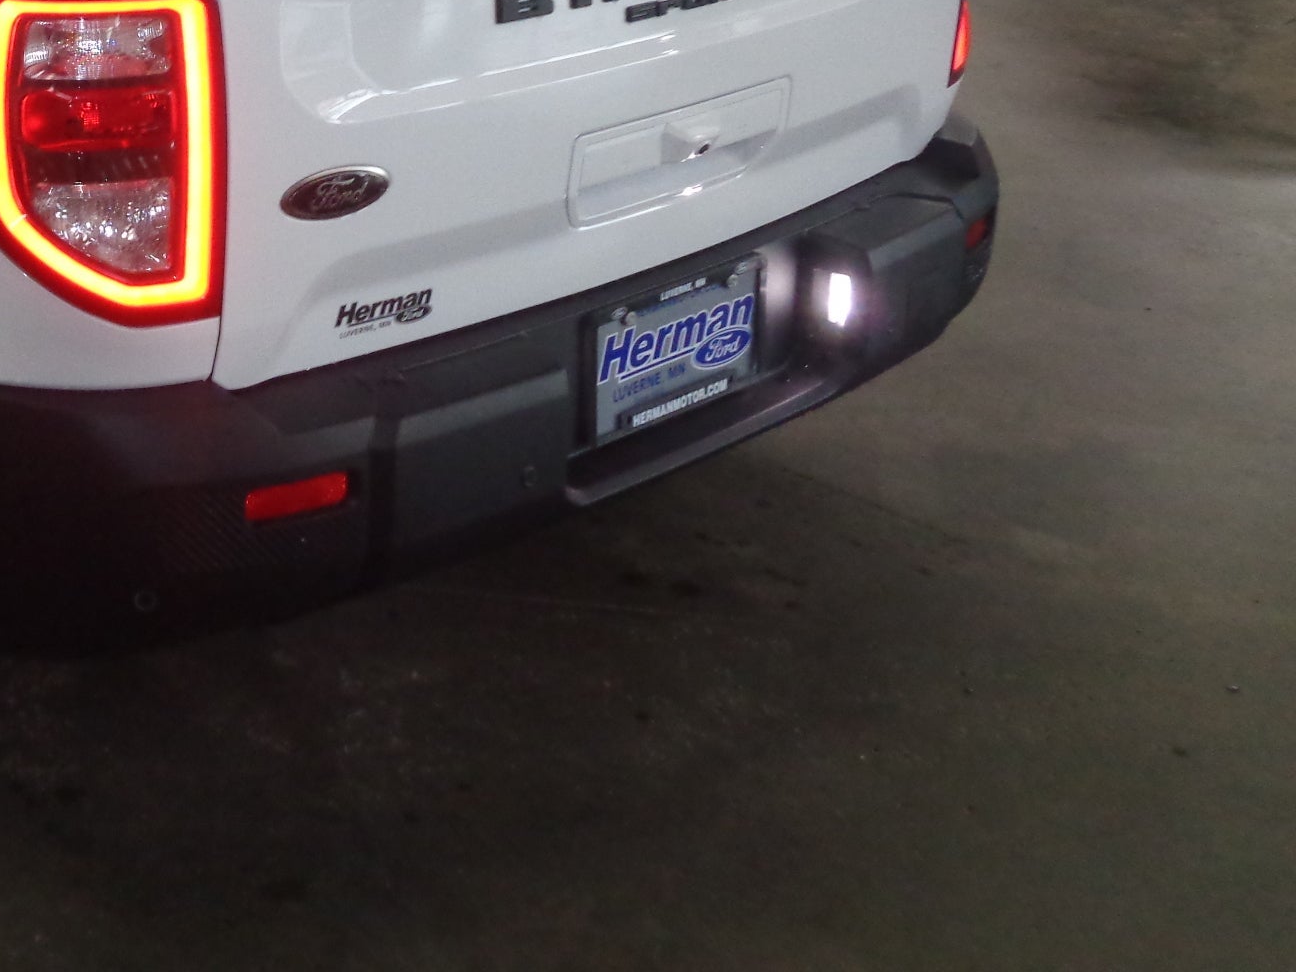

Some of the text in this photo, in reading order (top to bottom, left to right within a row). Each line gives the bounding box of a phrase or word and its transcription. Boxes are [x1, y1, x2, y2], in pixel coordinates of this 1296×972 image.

[335, 288, 432, 328] Herman
[597, 293, 754, 385] Herman
[705, 333, 740, 362] Ford
[632, 378, 728, 427] HERMANMOTOR.COM
